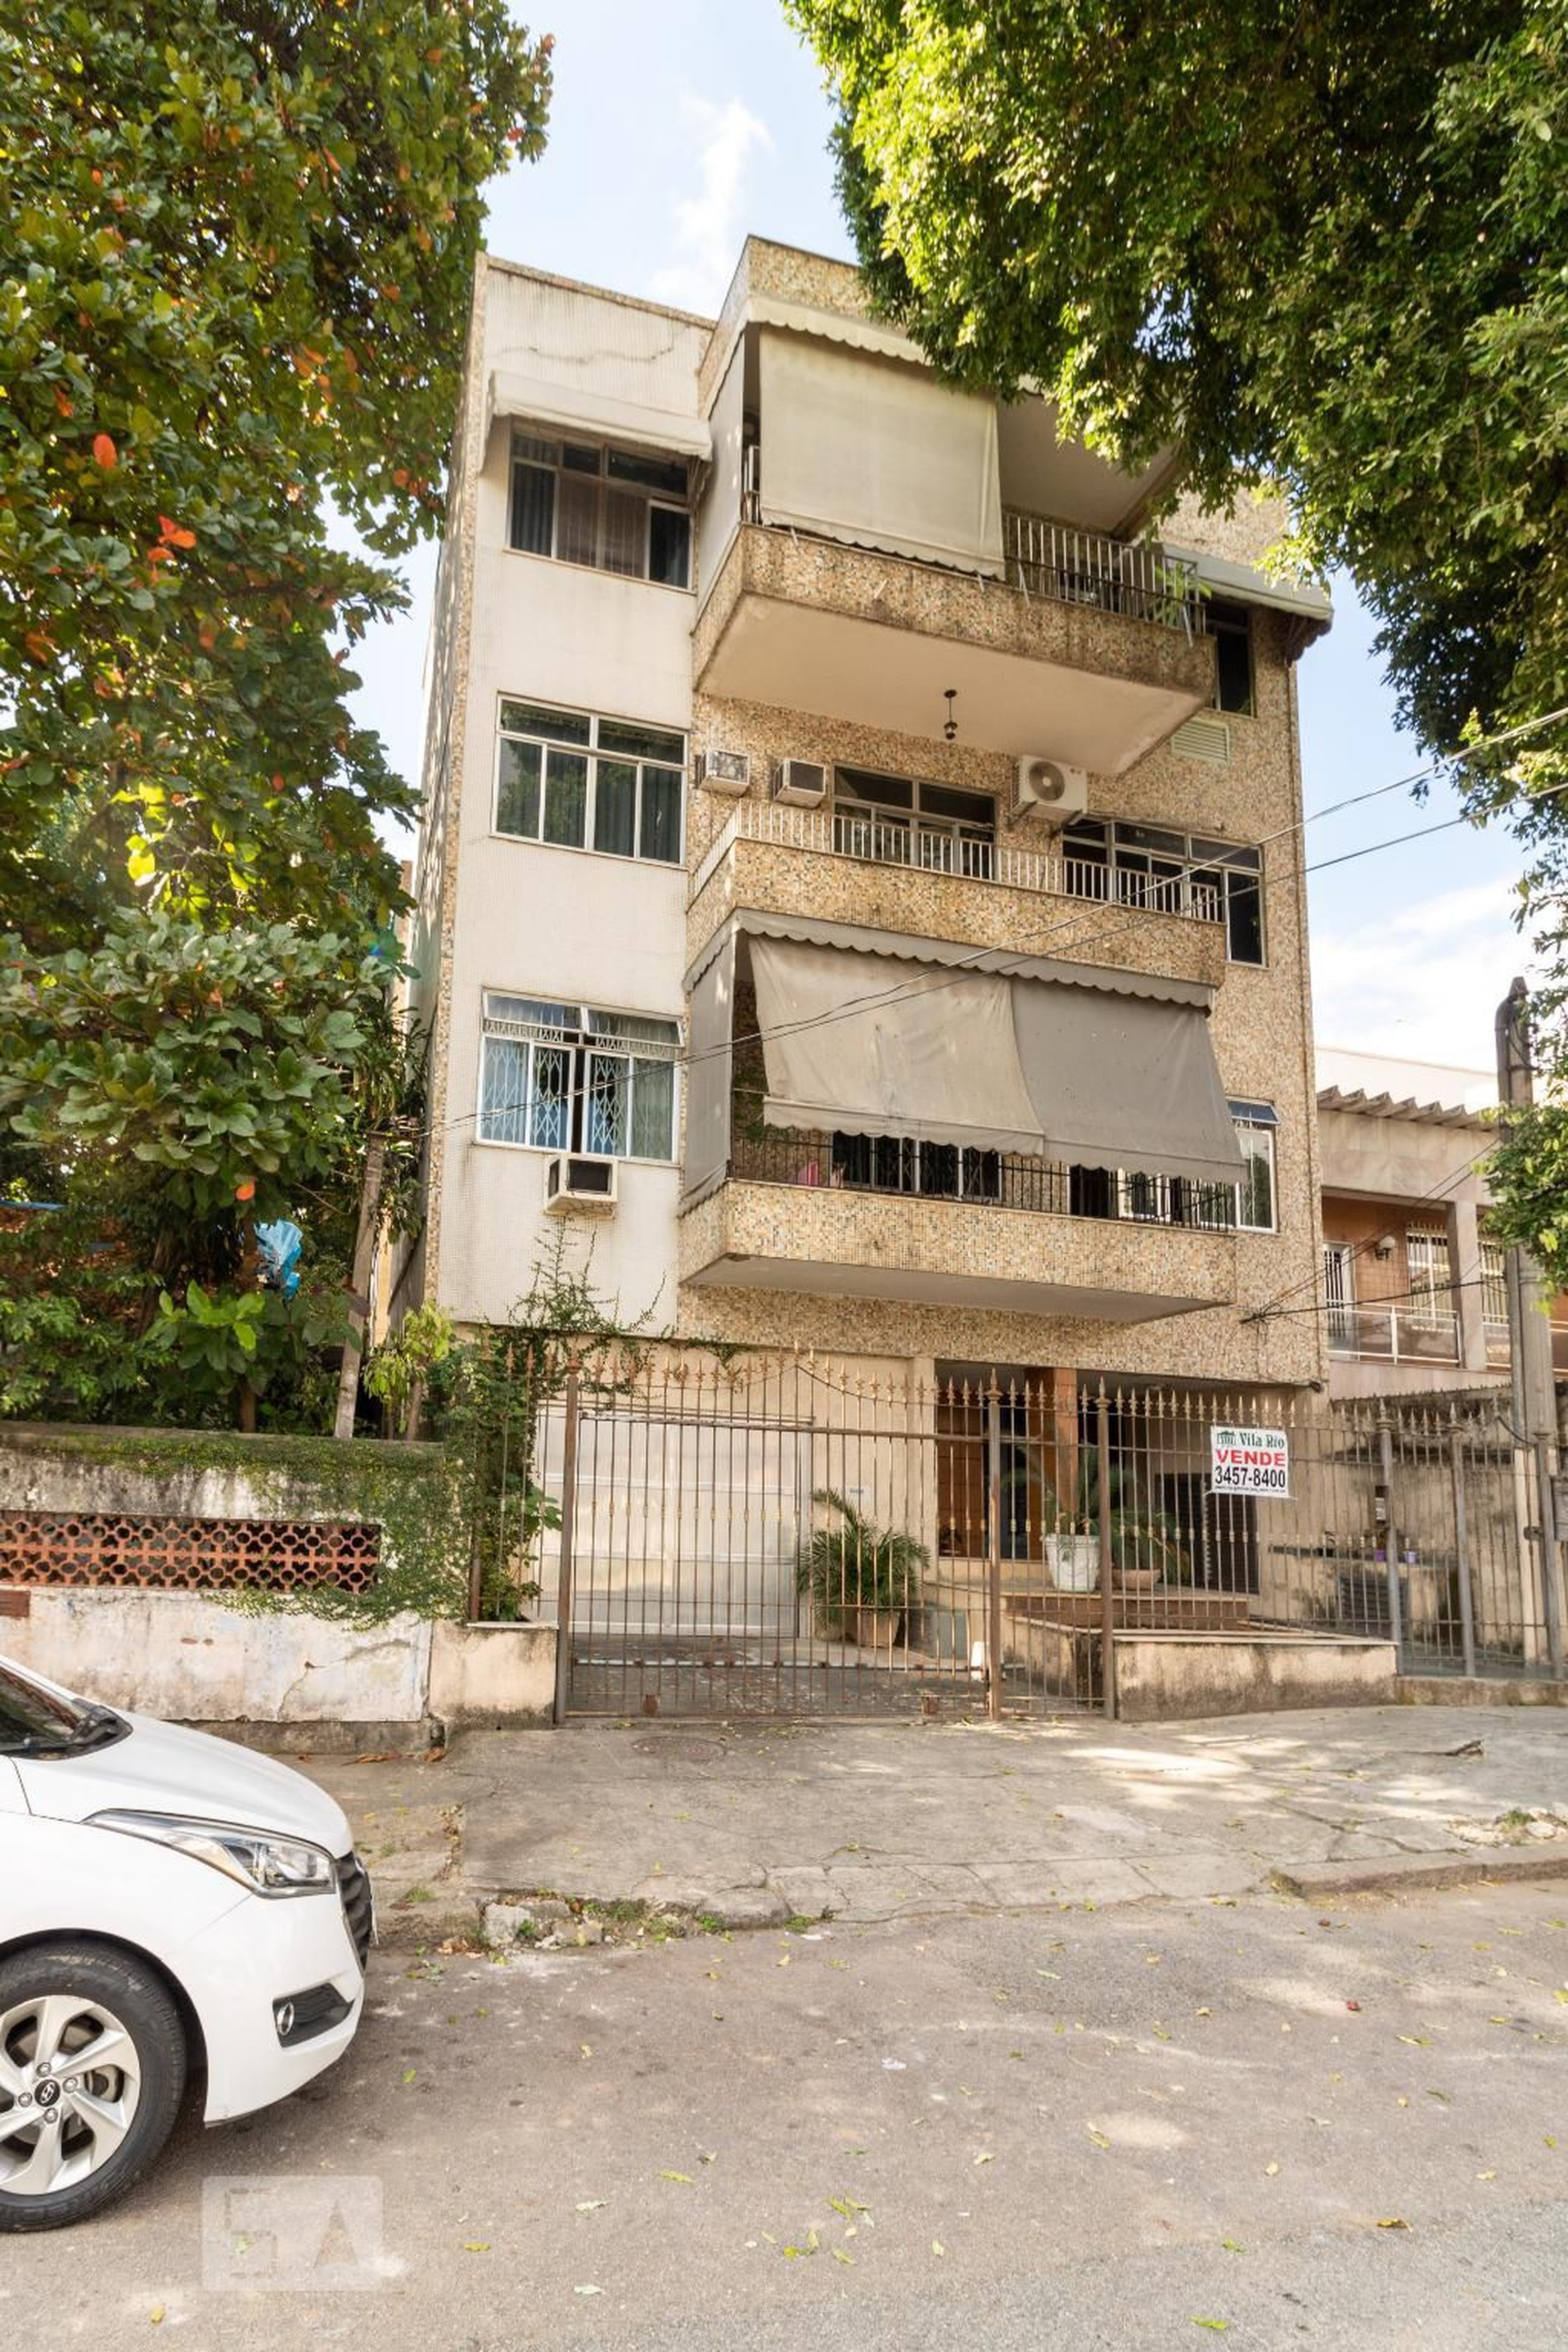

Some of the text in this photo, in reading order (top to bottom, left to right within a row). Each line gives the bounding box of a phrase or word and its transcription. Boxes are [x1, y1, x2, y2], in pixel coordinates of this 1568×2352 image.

[1239, 1433, 1285, 1449] Vila Rio
[1216, 1450, 1285, 1466] VENDE
[1215, 1466, 1285, 1488] 3457-8400
